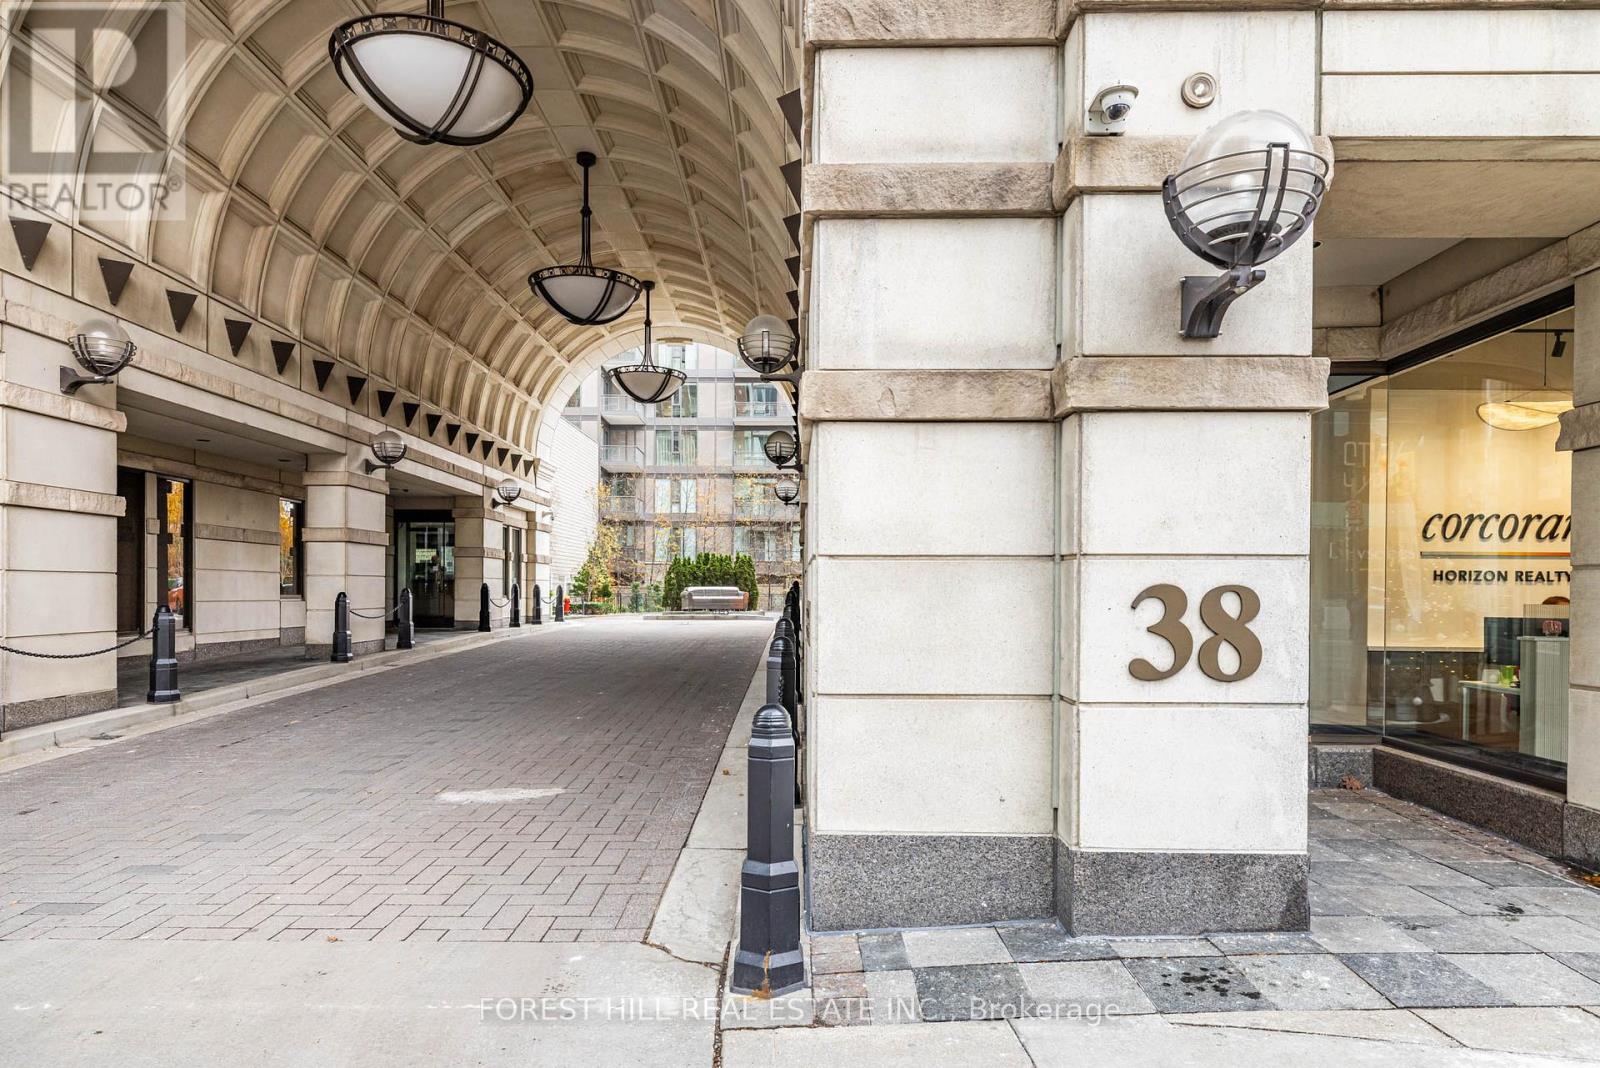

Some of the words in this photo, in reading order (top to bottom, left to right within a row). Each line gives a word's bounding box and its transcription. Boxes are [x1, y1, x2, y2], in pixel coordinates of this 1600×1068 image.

[1433, 570, 1508, 583] HORIZON
[1515, 571, 1571, 583] REALTY
[1128, 583, 1263, 682] 38
